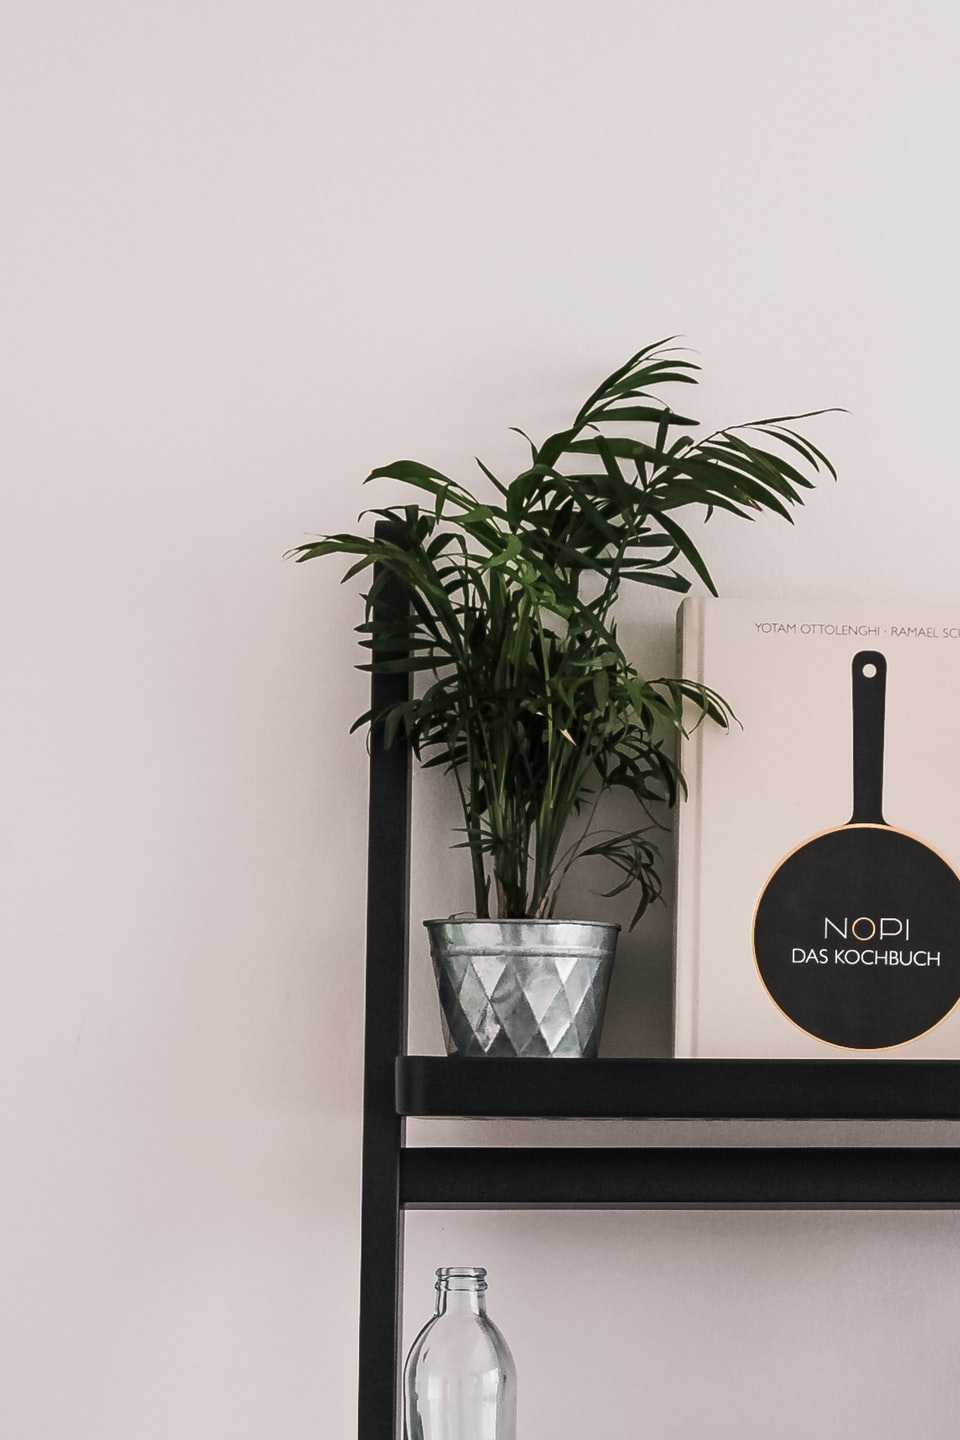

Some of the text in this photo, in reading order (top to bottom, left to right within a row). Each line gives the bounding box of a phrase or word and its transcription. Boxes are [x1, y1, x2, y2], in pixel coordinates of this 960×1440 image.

[755, 622, 797, 634] YOTAM
[800, 623, 880, 637] OTTOLENGHI
[890, 626, 938, 638] RAMAEL
[824, 917, 910, 941] NOPI
[791, 948, 941, 967] DAS KOCHBUCH
